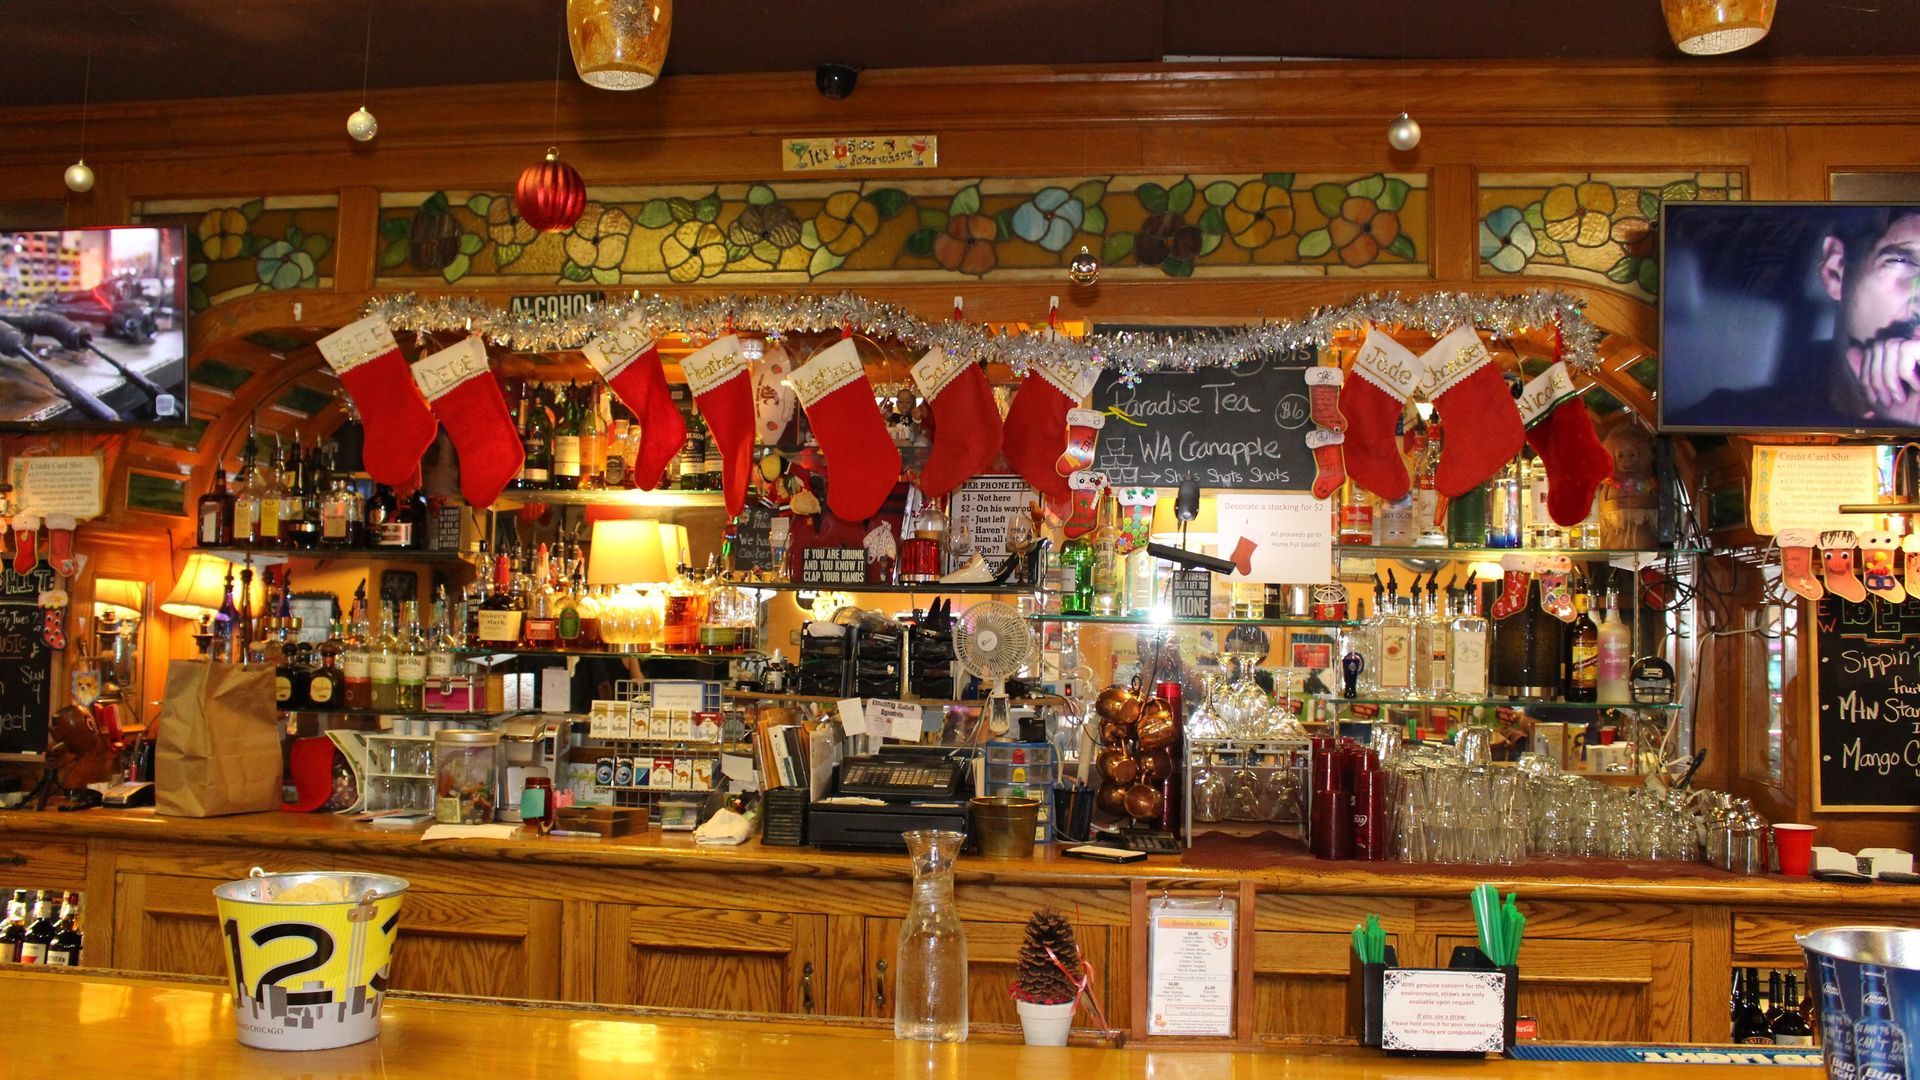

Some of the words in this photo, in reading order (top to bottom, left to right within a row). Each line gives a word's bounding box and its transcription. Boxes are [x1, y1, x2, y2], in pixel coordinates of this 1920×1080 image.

[807, 148, 829, 166] It's
[684, 351, 739, 382] Heather
[419, 354, 475, 393] DEDE
[1106, 379, 1201, 429] Paradise
[1201, 381, 1261, 415] Tea
[1280, 402, 1305, 420] $6
[1138, 430, 1173, 465] WA
[1179, 431, 1282, 466] Cranapple
[1808, 453, 1830, 461] Card
[1207, 467, 1244, 483] Shots
[1249, 467, 1291, 484] Shots
[962, 481, 979, 490] BAR
[980, 481, 1010, 490] PHONE
[962, 494, 971, 502] $1
[977, 493, 992, 502] Not
[993, 493, 1012, 502] here
[961, 505, 970, 513] $2
[976, 505, 989, 513] On
[990, 505, 1002, 513] his
[1003, 507, 1021, 515] way
[1224, 502, 1260, 511] Decorate
[1267, 502, 1300, 512] stocking
[1301, 501, 1313, 511] for
[1314, 502, 1325, 511] $2
[975, 515, 990, 525] Just
[992, 515, 1006, 524] left
[975, 526, 1006, 535] Haven't
[1279, 531, 1306, 539] proceeds
[974, 534, 992, 543] him
[993, 534, 1004, 543] all
[803, 548, 810, 560] IF
[811, 548, 826, 560] YOU
[826, 548, 839, 560] ARE
[841, 549, 865, 560] DRUNK
[803, 559, 818, 571] AND
[819, 560, 833, 571] YOU
[835, 560, 856, 571] KNOW
[857, 560, 865, 571] IT
[803, 571, 821, 583] CLAP
[822, 571, 840, 582] YOUR
[841, 571, 865, 583] HANDS
[1175, 596, 1209, 616] ALONE
[1842, 646, 1914, 678] Sippin'
[1842, 737, 1900, 775] Mango
[1832, 1056, 1856, 1074] BUD
